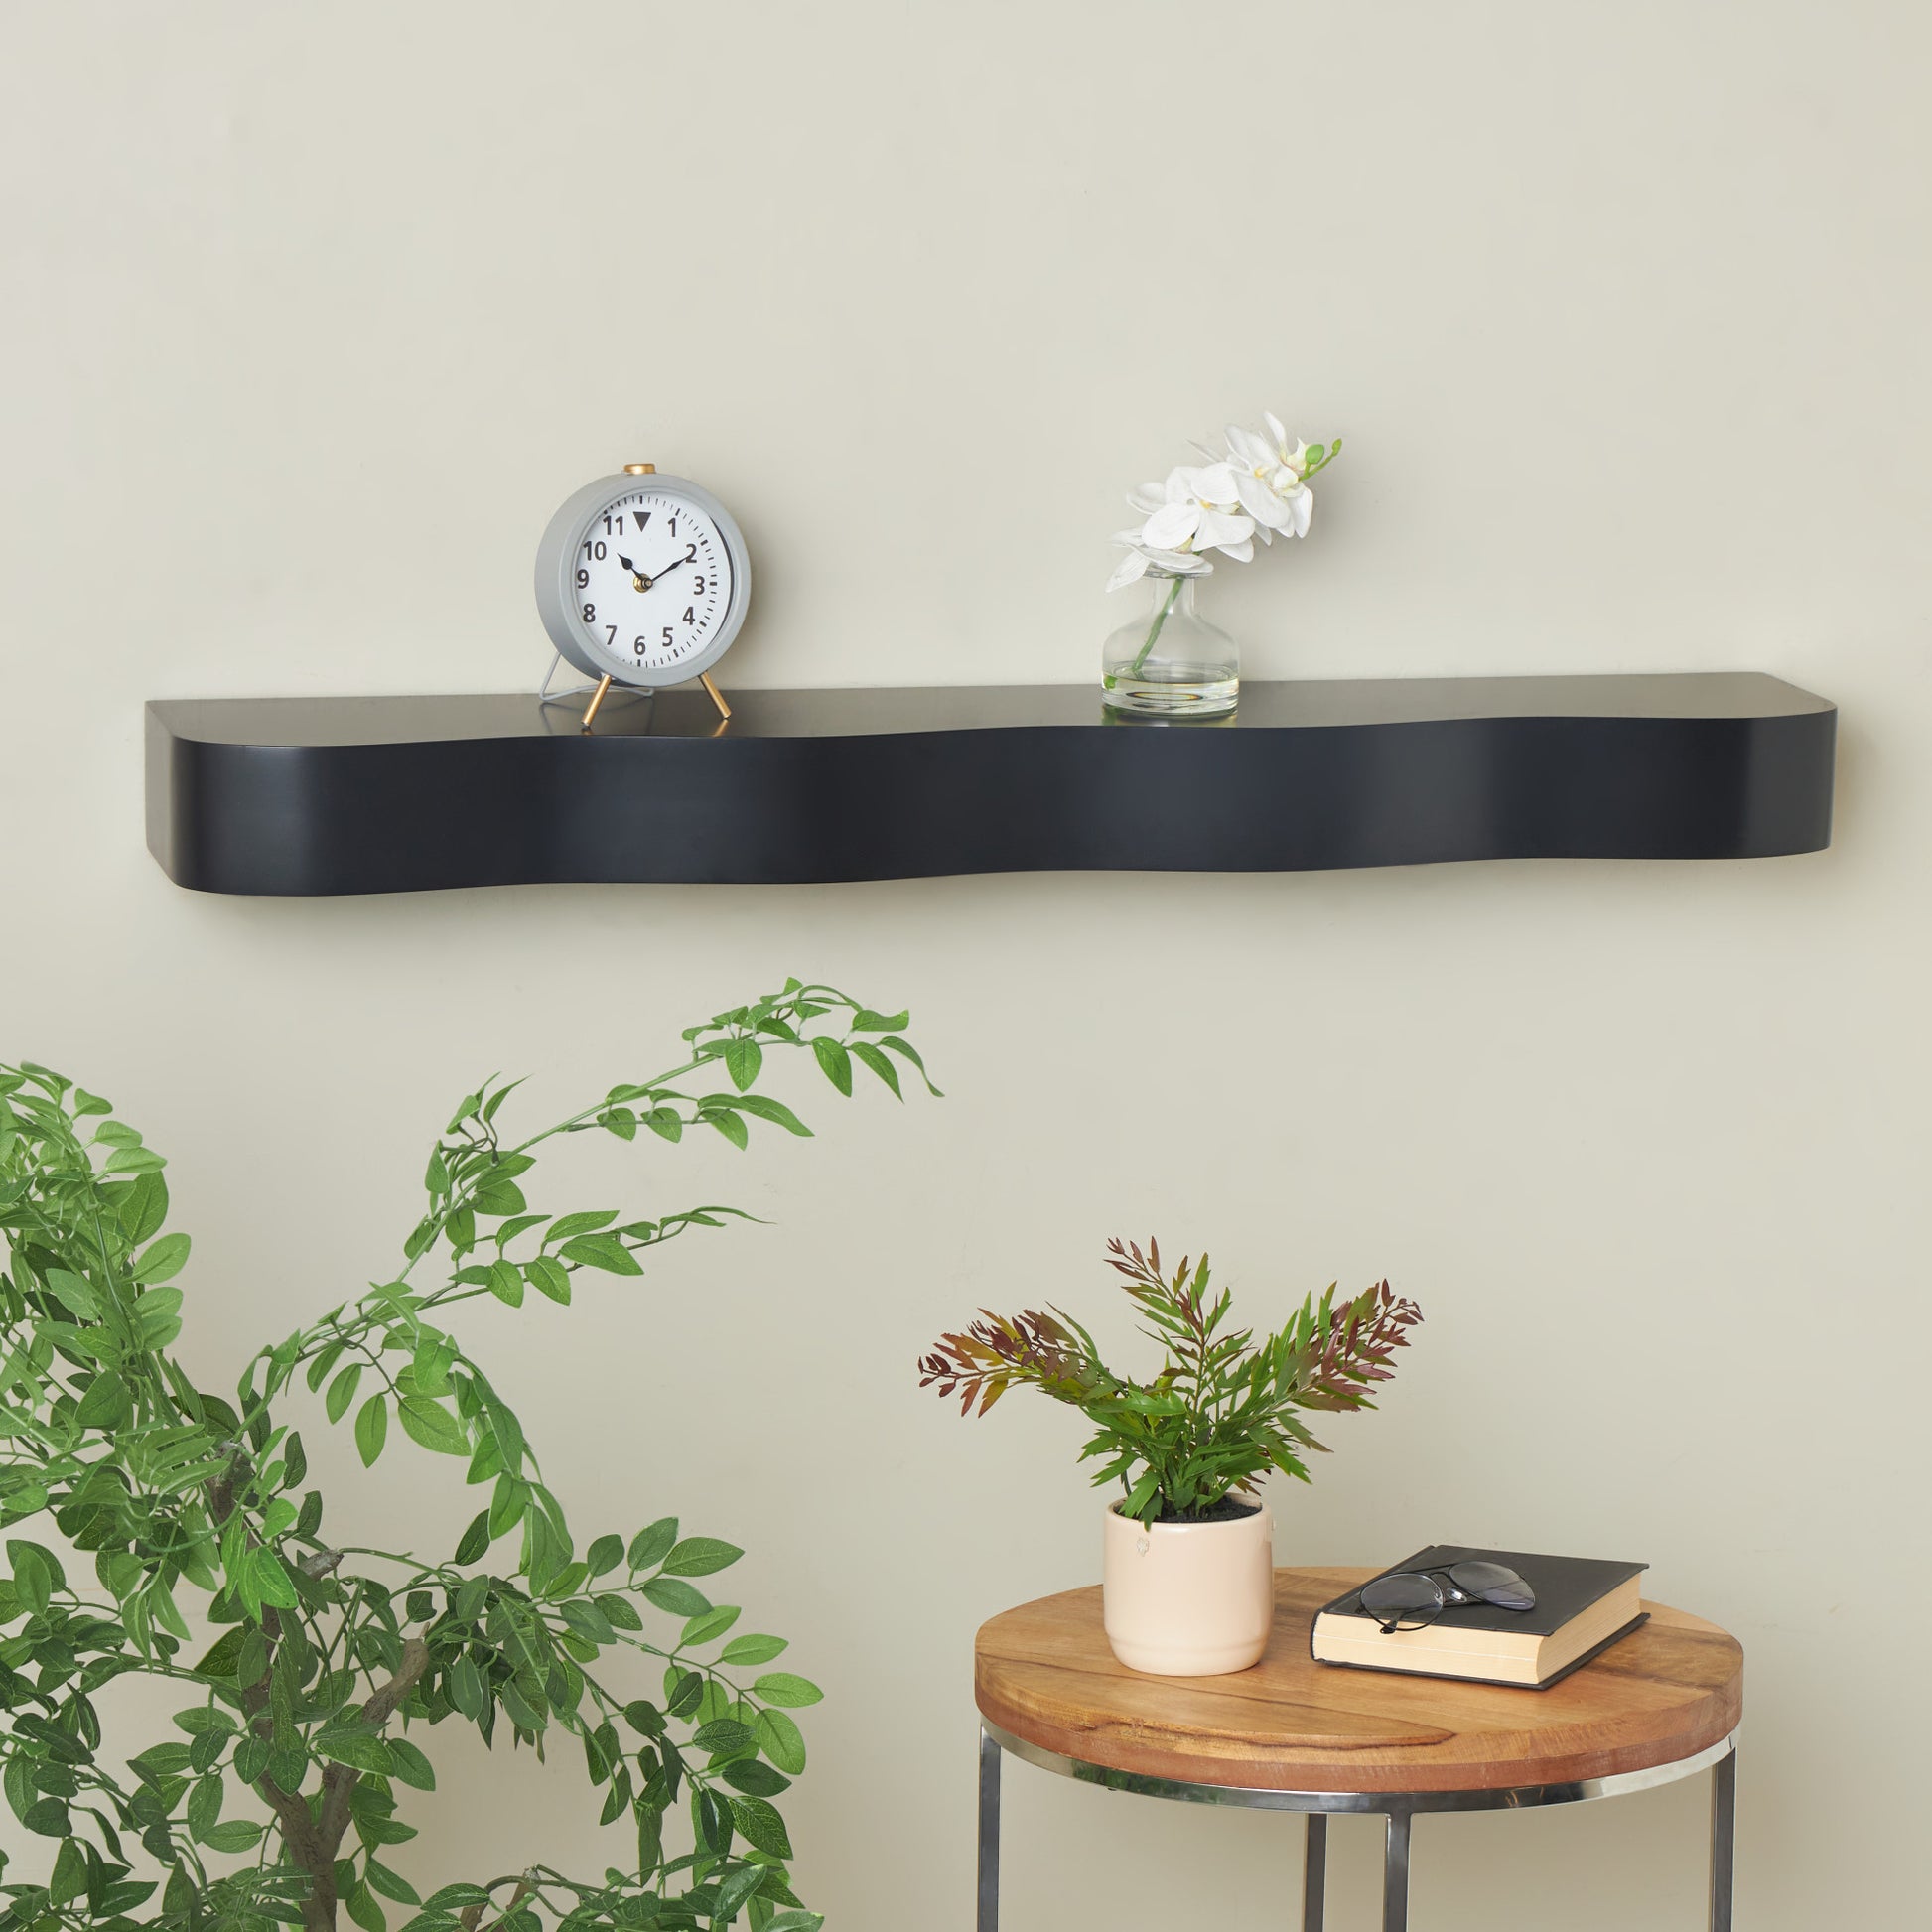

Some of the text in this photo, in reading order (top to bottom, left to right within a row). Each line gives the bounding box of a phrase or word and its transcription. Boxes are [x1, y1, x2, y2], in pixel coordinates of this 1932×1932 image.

[603, 515, 623, 536] 11
[667, 517, 677, 538] 1
[583, 541, 607, 561] 10
[685, 543, 698, 564] 2
[577, 569, 590, 590] 9
[693, 575, 706, 596] 3
[583, 603, 596, 623] 8
[682, 606, 696, 626] 4
[605, 624, 618, 646] 7
[633, 635, 646, 656] 6
[662, 626, 674, 647] 5
